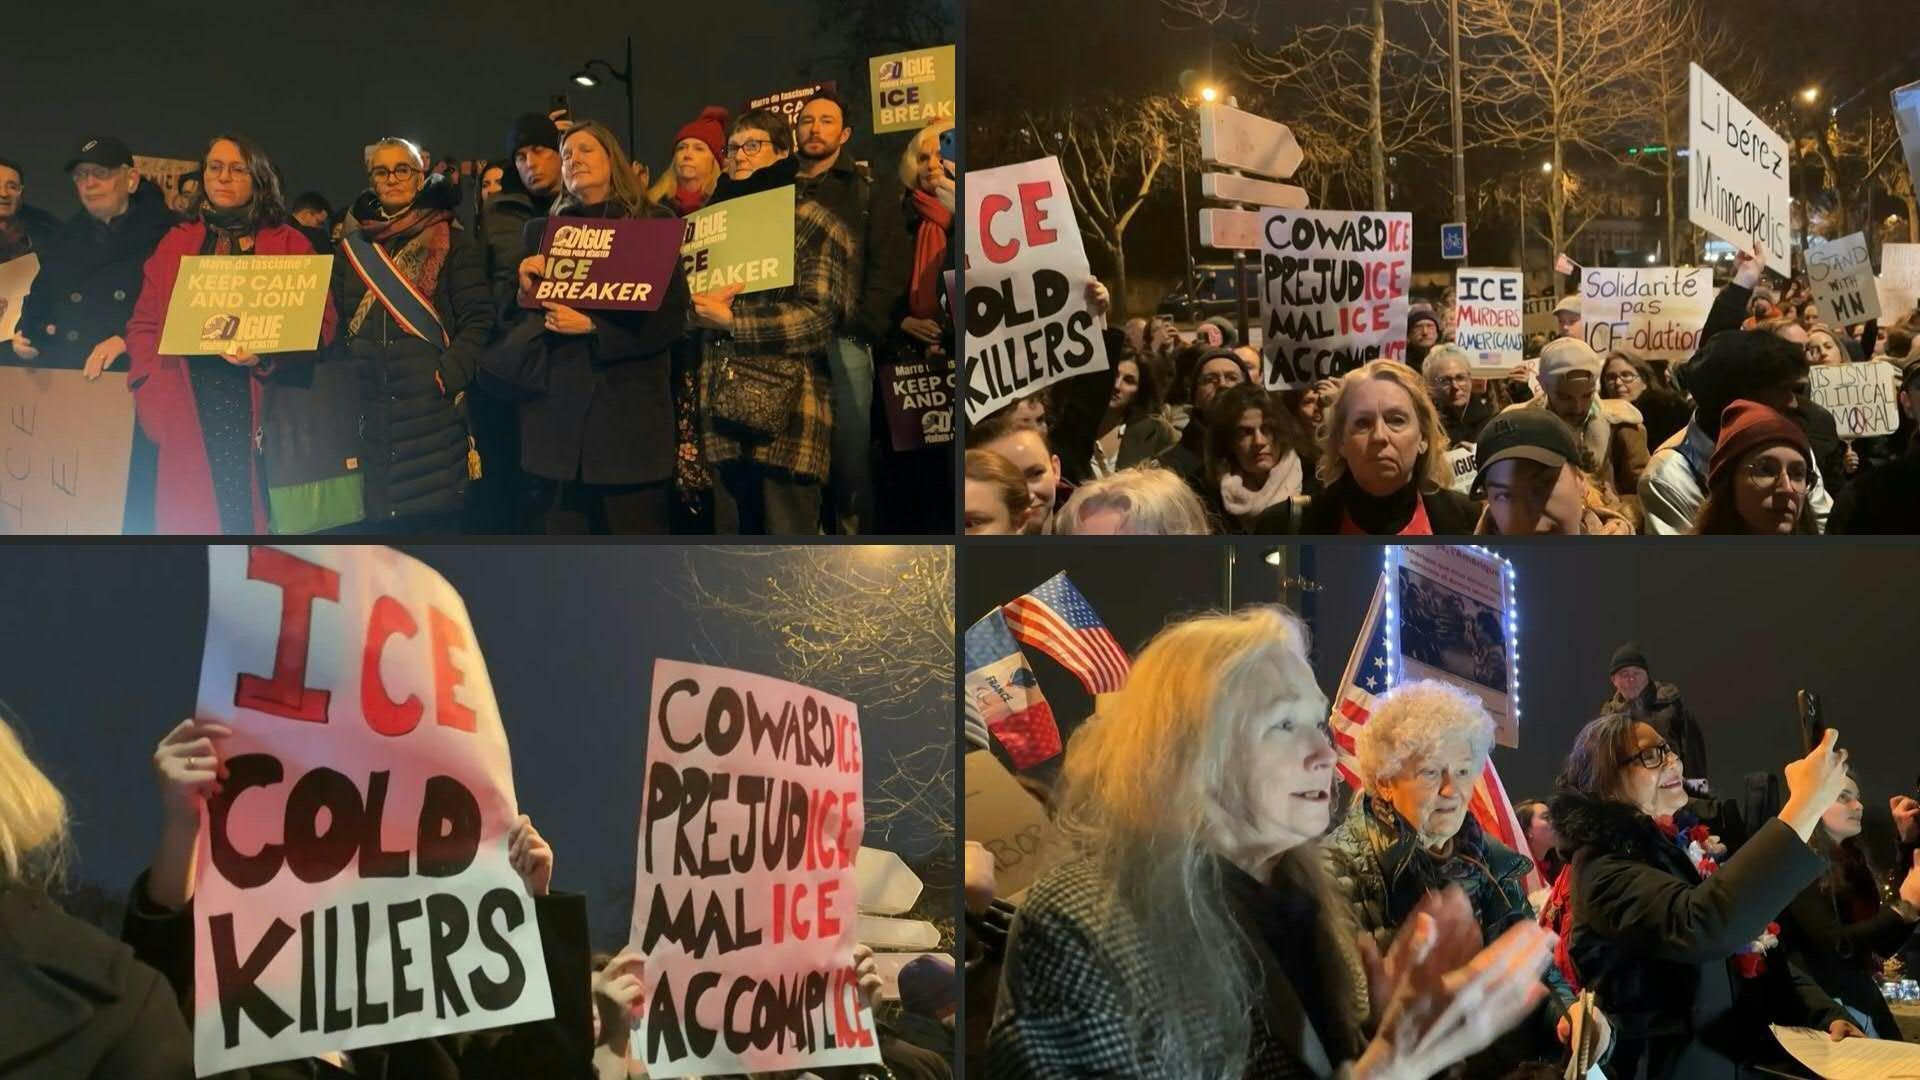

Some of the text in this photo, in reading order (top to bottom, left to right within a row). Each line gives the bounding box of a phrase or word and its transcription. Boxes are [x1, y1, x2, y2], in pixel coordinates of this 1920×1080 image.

[880, 86, 919, 109] ICE
[880, 100, 953, 125] BREAK
[1700, 72, 1783, 180] Libérez
[1696, 150, 1785, 260] Minneapolis
[965, 181, 1058, 270] CE
[1265, 215, 1410, 252] COWARDICE
[235, 258, 249, 270] du
[251, 257, 300, 270] fascisme
[544, 257, 592, 280] ICE
[682, 248, 709, 275] CE
[1809, 246, 1868, 281] STAND
[187, 273, 318, 291] KEEP CALM
[535, 281, 653, 301] BREAKER
[1264, 254, 1405, 306] PREJUDICE
[1458, 276, 1518, 302] ICE
[1586, 270, 1699, 298] Solidarité
[1828, 275, 1858, 291] WITH
[190, 291, 306, 308] AND JOIN
[965, 269, 1070, 338] OLD
[1620, 300, 1662, 321] pas
[1831, 291, 1866, 321] MN
[1456, 304, 1520, 328] MURDERS
[893, 375, 942, 396] KEEP
[1811, 382, 1896, 408] OLITICAL
[903, 391, 947, 411] AND
[234, 545, 478, 737] ICE
[984, 674, 1014, 703] FRANCE
[658, 678, 860, 774] COWARDICE
[208, 753, 482, 890] COLD
[645, 761, 858, 877] PREJUDICE
[208, 888, 527, 1050] KILLERS
[647, 964, 873, 1065] ACCOMPLICE
